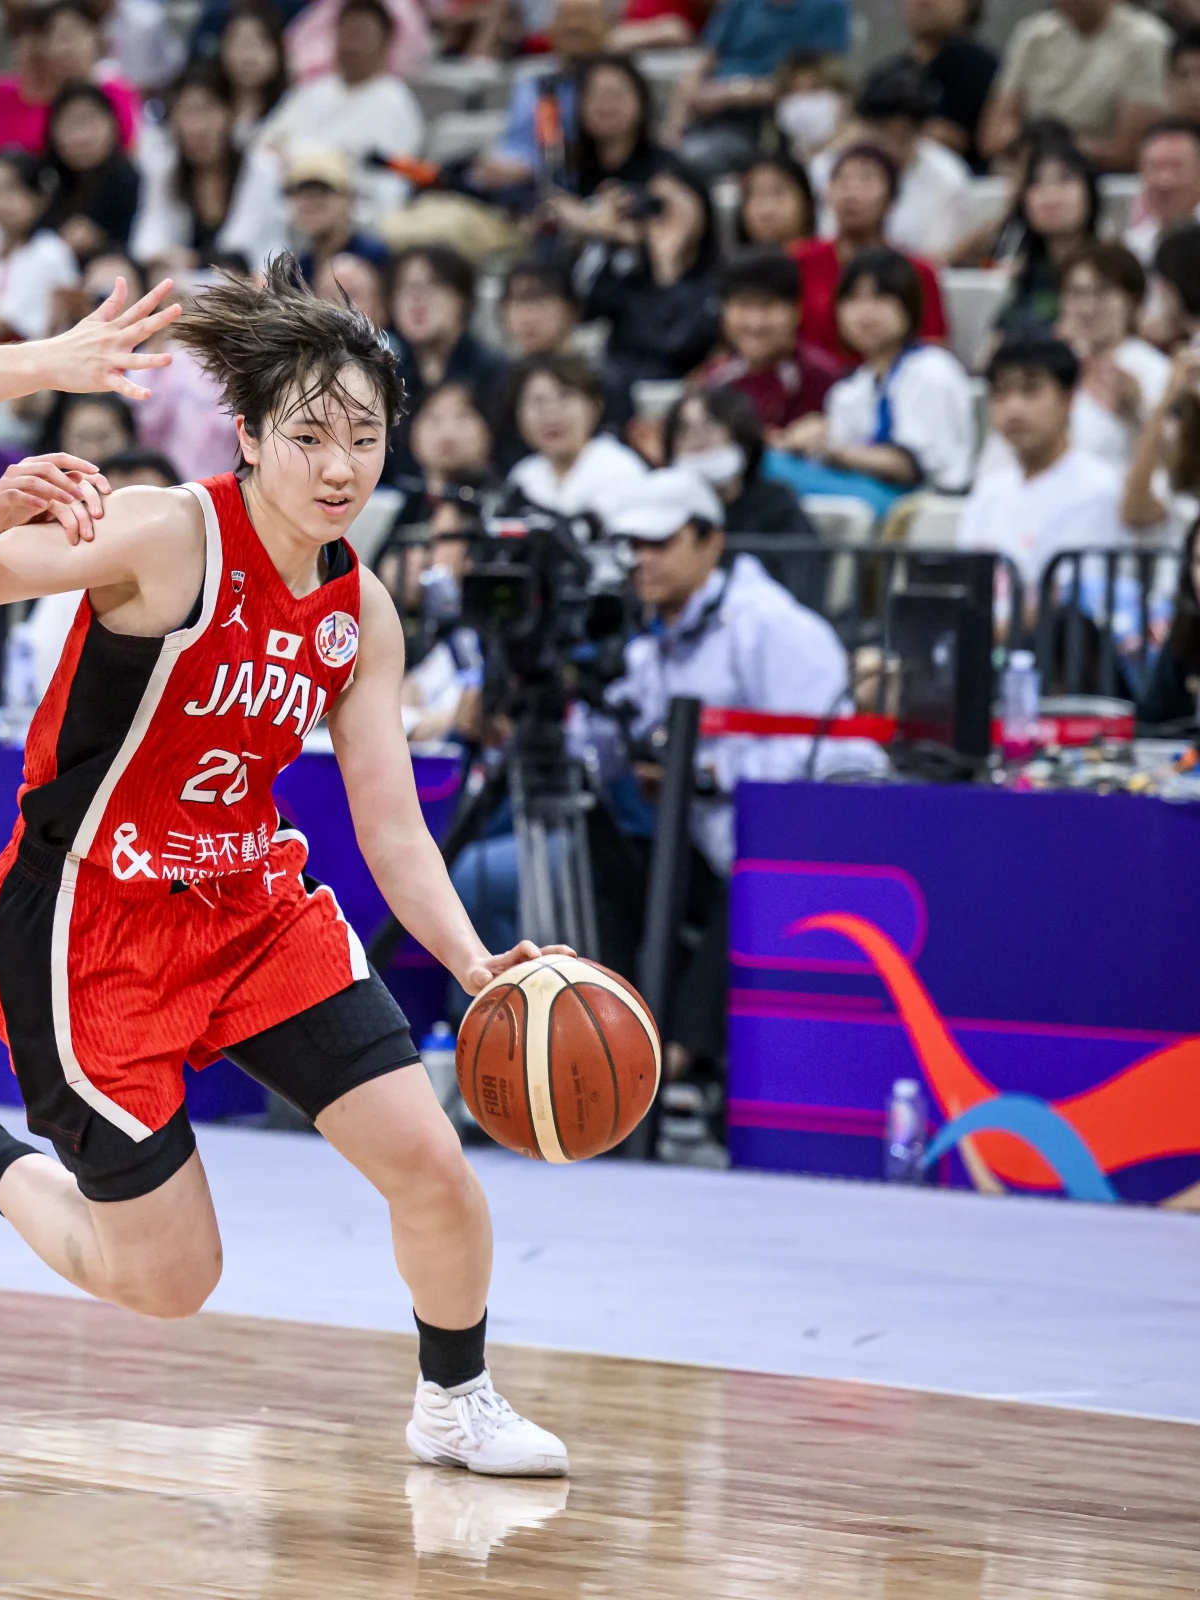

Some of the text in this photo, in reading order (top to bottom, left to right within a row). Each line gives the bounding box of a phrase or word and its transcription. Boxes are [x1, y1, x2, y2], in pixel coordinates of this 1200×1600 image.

[183, 661, 328, 741] JAPAN
[161, 822, 270, 866] 三井不動産
[481, 1075, 501, 1117] FIBA
